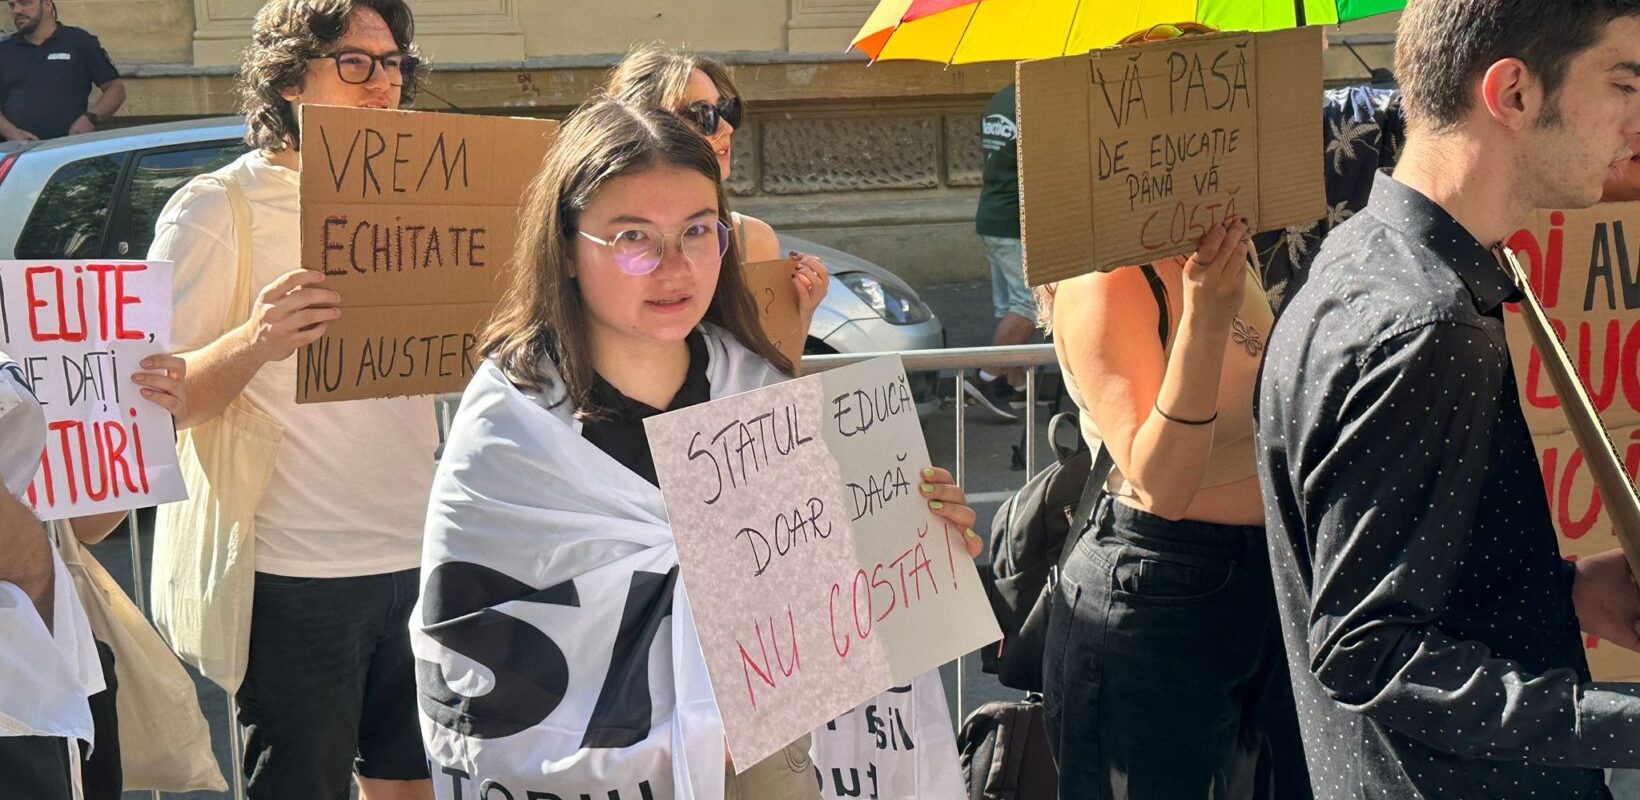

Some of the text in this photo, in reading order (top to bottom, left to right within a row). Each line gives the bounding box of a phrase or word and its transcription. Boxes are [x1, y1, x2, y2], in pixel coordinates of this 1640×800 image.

[1096, 41, 1251, 129] VĂ PASĂ
[319, 125, 469, 199] VREM
[1098, 137, 1130, 181] DE
[1126, 163, 1220, 211] PÂNĂ VĂ
[1140, 186, 1240, 250] COSTĂ
[305, 335, 344, 399] NU
[687, 375, 912, 505] STATUL EDUCĂ
[735, 452, 911, 577] DOAR DACĂ
[735, 605, 800, 712] NU
